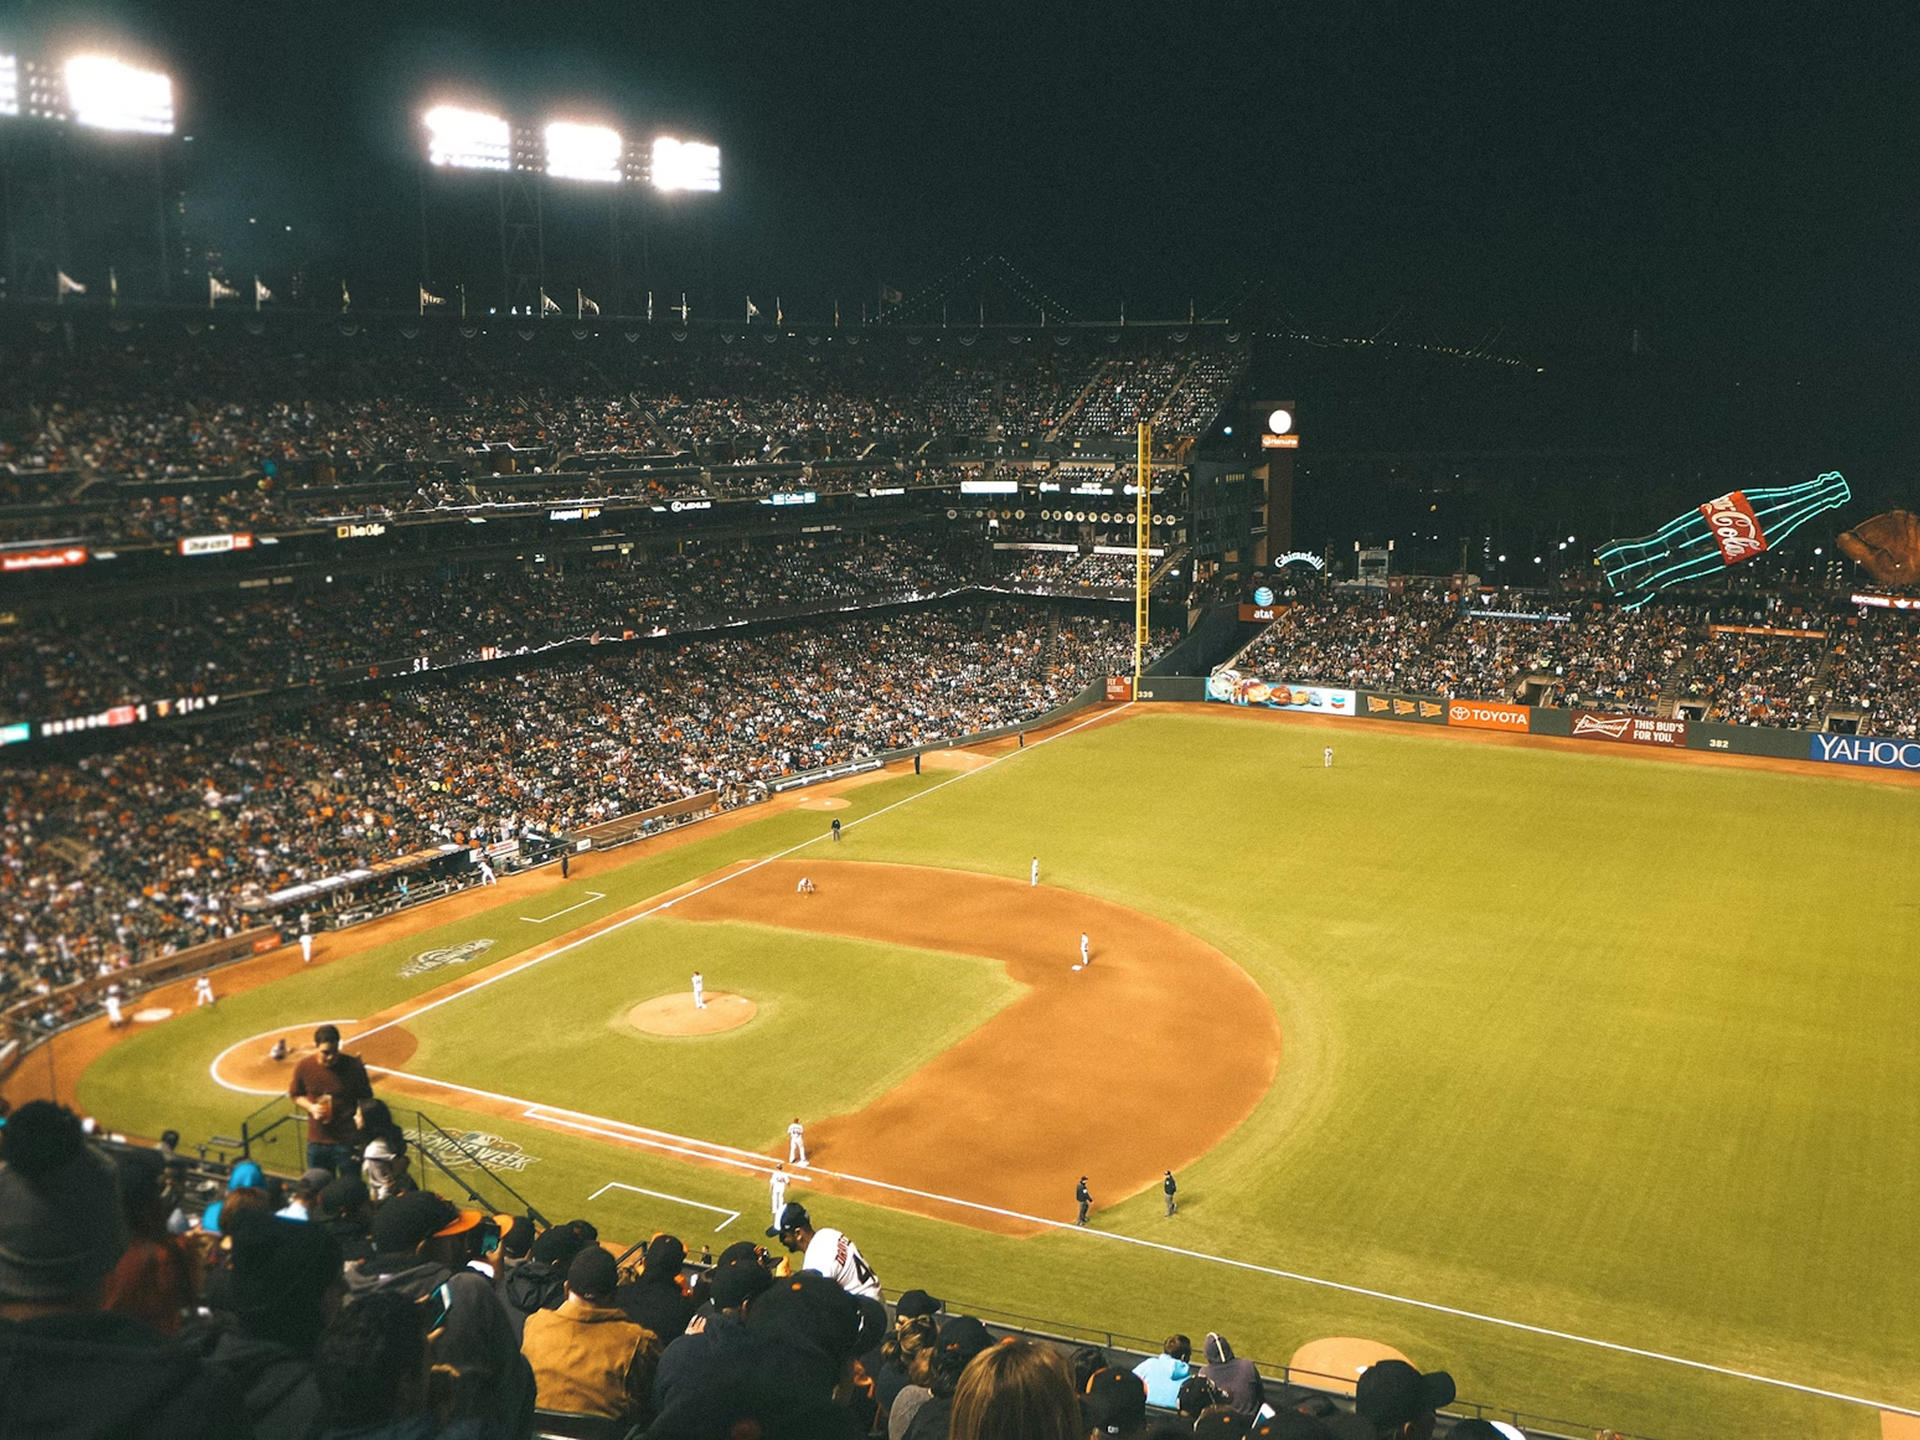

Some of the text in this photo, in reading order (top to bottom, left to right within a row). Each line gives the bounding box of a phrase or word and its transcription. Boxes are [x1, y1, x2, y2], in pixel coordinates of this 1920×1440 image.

[1274, 550, 1325, 570] Ghirardelli
[1472, 709, 1528, 725] TOYOTA
[1634, 719, 1685, 734] THIS BUD'S
[1633, 731, 1674, 743] FOR YOU.
[474, 1147, 530, 1171] WEEK
